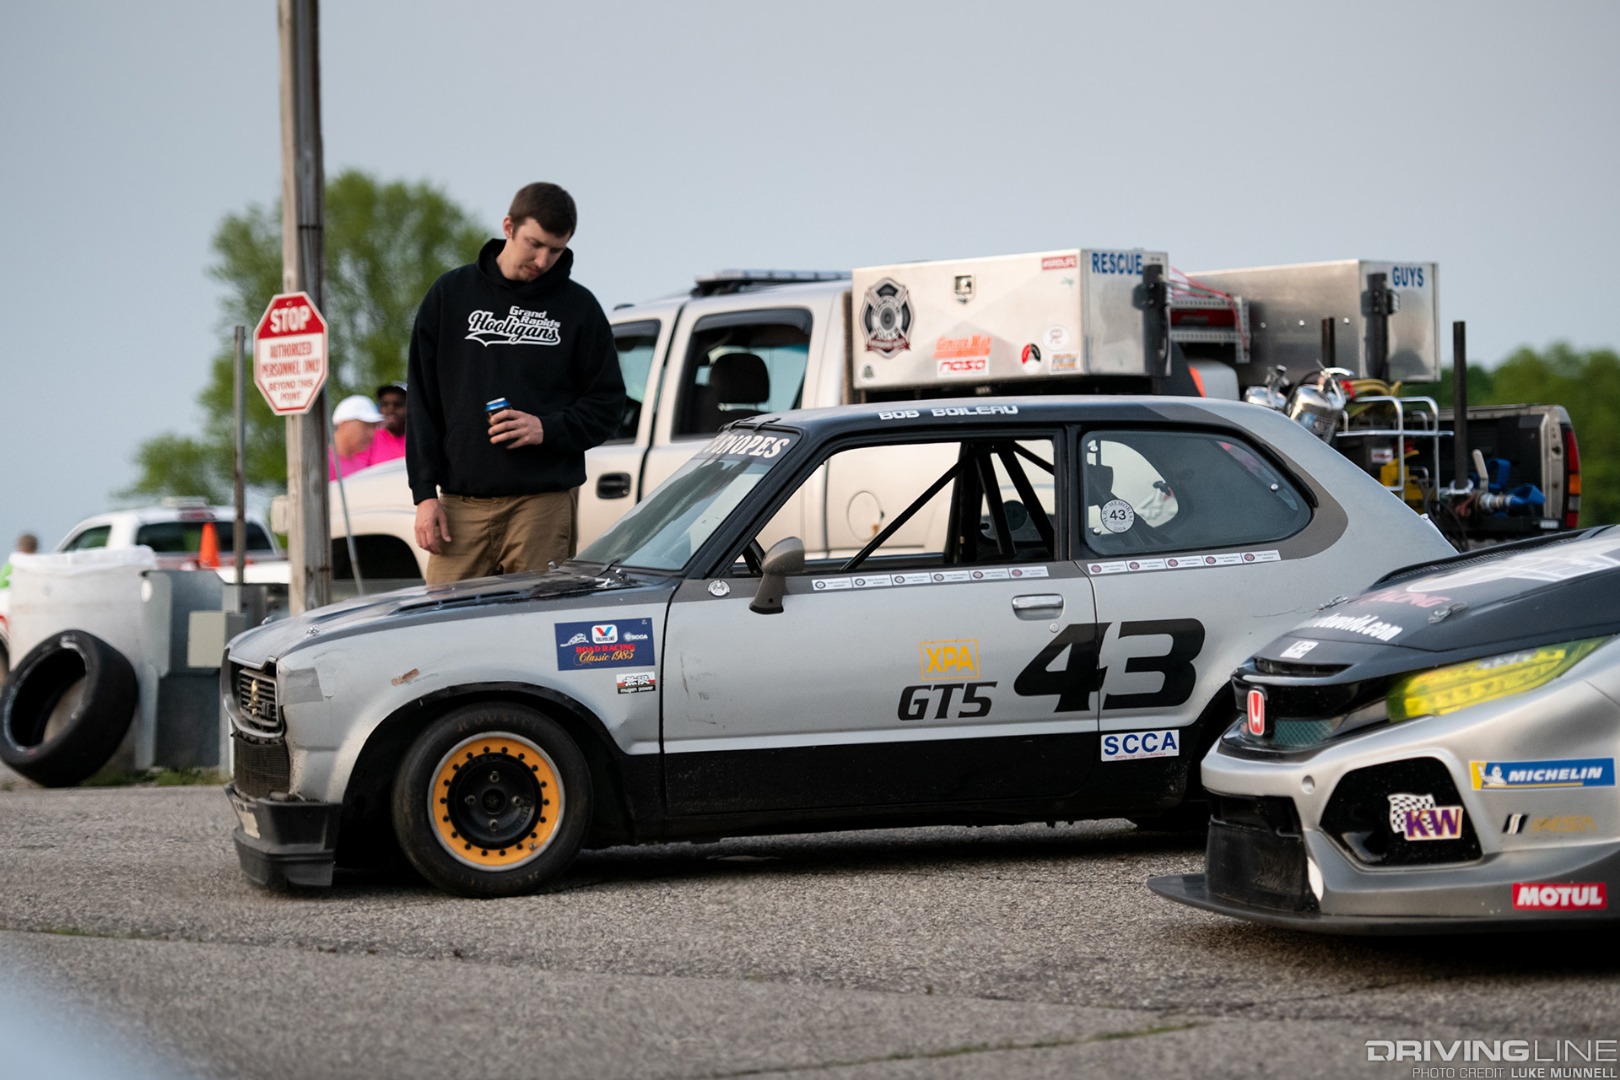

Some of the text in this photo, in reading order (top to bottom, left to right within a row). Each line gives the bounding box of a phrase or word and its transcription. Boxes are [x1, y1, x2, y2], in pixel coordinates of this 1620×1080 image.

[1092, 252, 1143, 276] RESCUE
[1392, 266, 1424, 288] GUYS
[269, 306, 311, 333] STOP
[509, 305, 547, 319] Grand
[467, 309, 560, 344] Hooligans
[520, 315, 561, 328] Rapids
[270, 341, 312, 358] AUTHORIZED
[262, 361, 300, 378] PERSONNEL
[269, 381, 296, 392] BEYOND
[281, 391, 302, 401] POINT
[879, 405, 1019, 421] BOB BOILEAU
[1109, 509, 1127, 521] 43
[575, 643, 635, 653] ROAD RACING
[577, 649, 635, 664] Classic 1985
[925, 645, 975, 673] XPA
[1012, 617, 1206, 713] 43
[1104, 731, 1177, 755] SCCA
[1508, 767, 1603, 783] MICHELIN
[1405, 808, 1459, 838] KW
[1517, 886, 1603, 907] MOTUL
